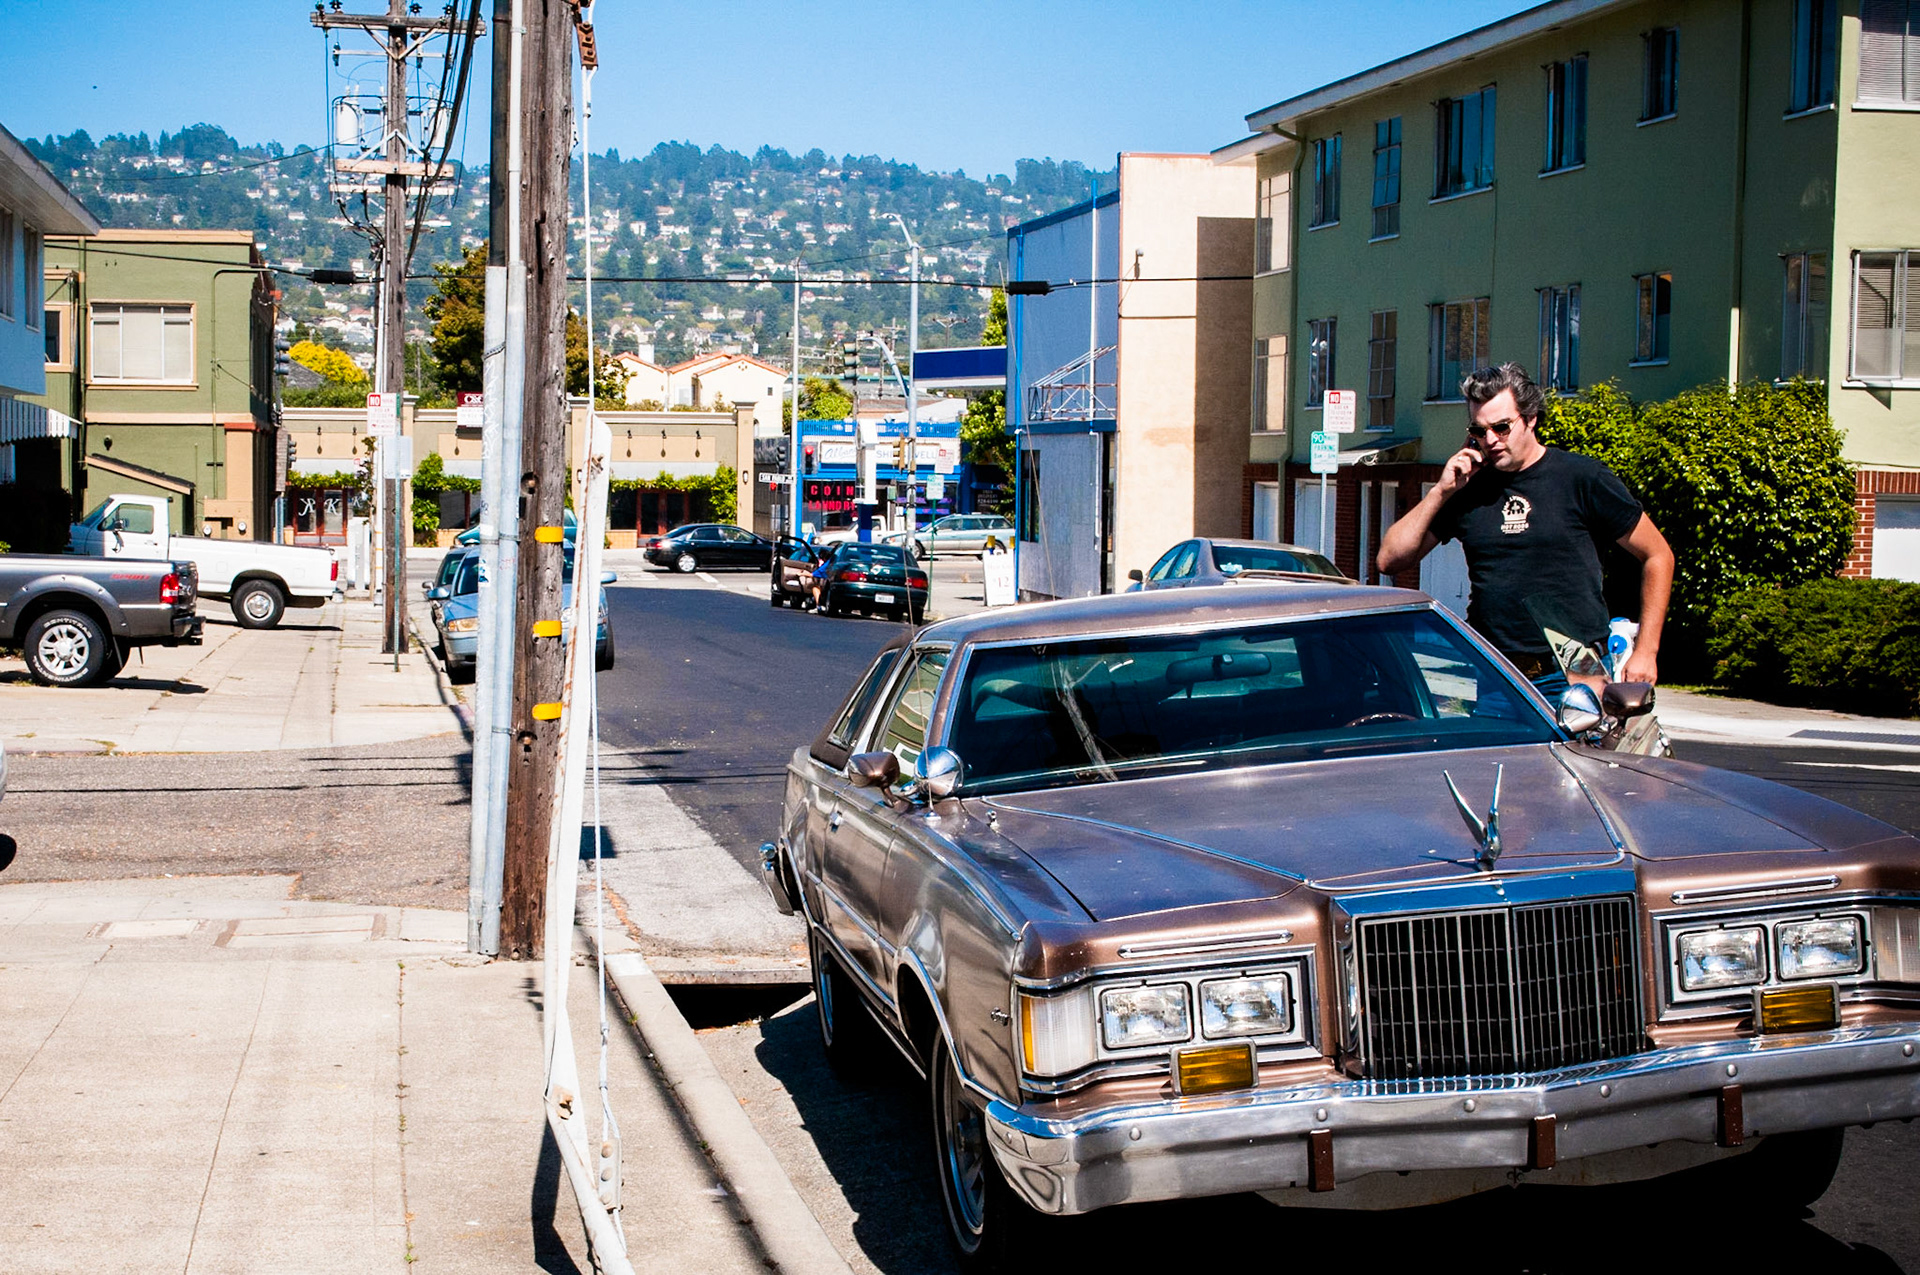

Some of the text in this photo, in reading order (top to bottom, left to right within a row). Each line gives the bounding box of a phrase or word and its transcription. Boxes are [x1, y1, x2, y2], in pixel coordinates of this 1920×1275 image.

[369, 396, 380, 405] NO
[1330, 393, 1340, 403] NO
[1313, 434, 1324, 443] 90
[810, 484, 854, 496] COIN
[324, 498, 343, 515] K
[808, 500, 856, 511] LAUNDRY
